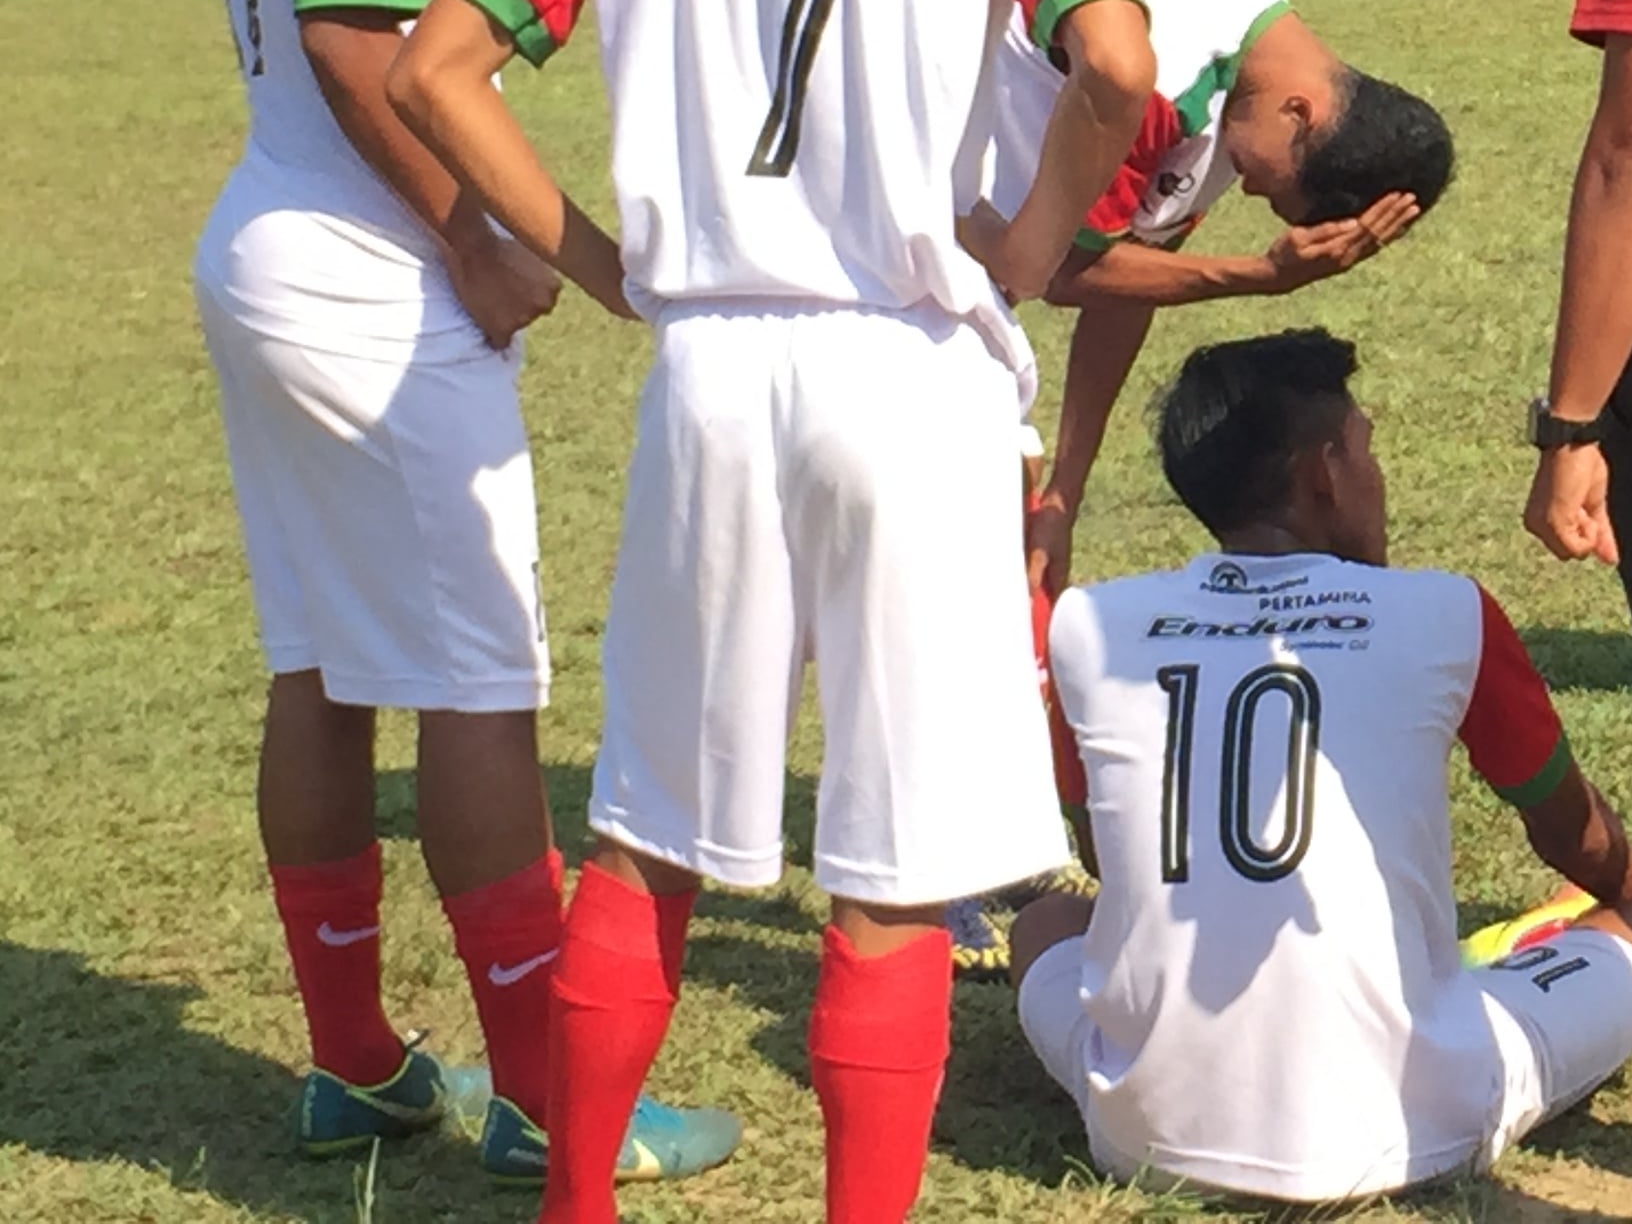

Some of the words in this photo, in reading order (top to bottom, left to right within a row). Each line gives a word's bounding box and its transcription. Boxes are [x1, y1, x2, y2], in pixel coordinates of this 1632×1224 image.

[1258, 590, 1373, 612] PERTAMINA
[1146, 614, 1372, 639] Enduro
[1155, 662, 1322, 884] 10
